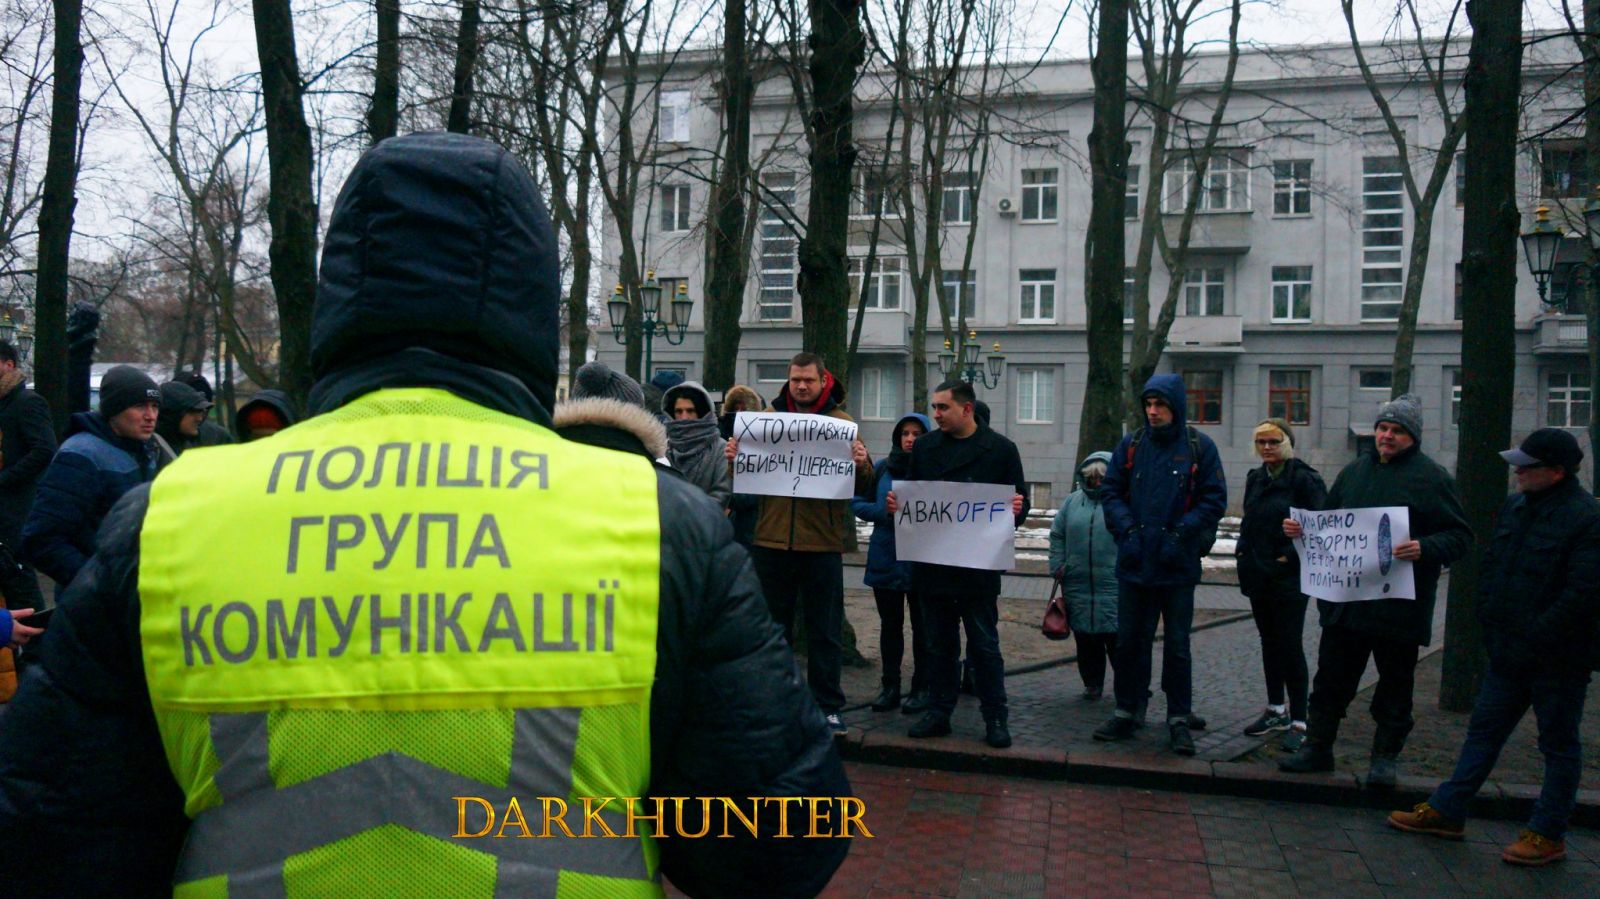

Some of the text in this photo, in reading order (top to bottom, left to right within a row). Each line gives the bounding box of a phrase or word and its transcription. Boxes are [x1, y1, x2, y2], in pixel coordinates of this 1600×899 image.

[738, 416, 785, 444] ХТО
[266, 442, 549, 494] ПОЛІЦІЯ
[798, 454, 854, 477] ШЕРЕМЕТА
[792, 476, 801, 495] ?
[286, 513, 511, 574] ГРУПА
[1301, 533, 1368, 551] РЕФОРМУ
[180, 579, 619, 667] КОМУНІКАЦІЇ
